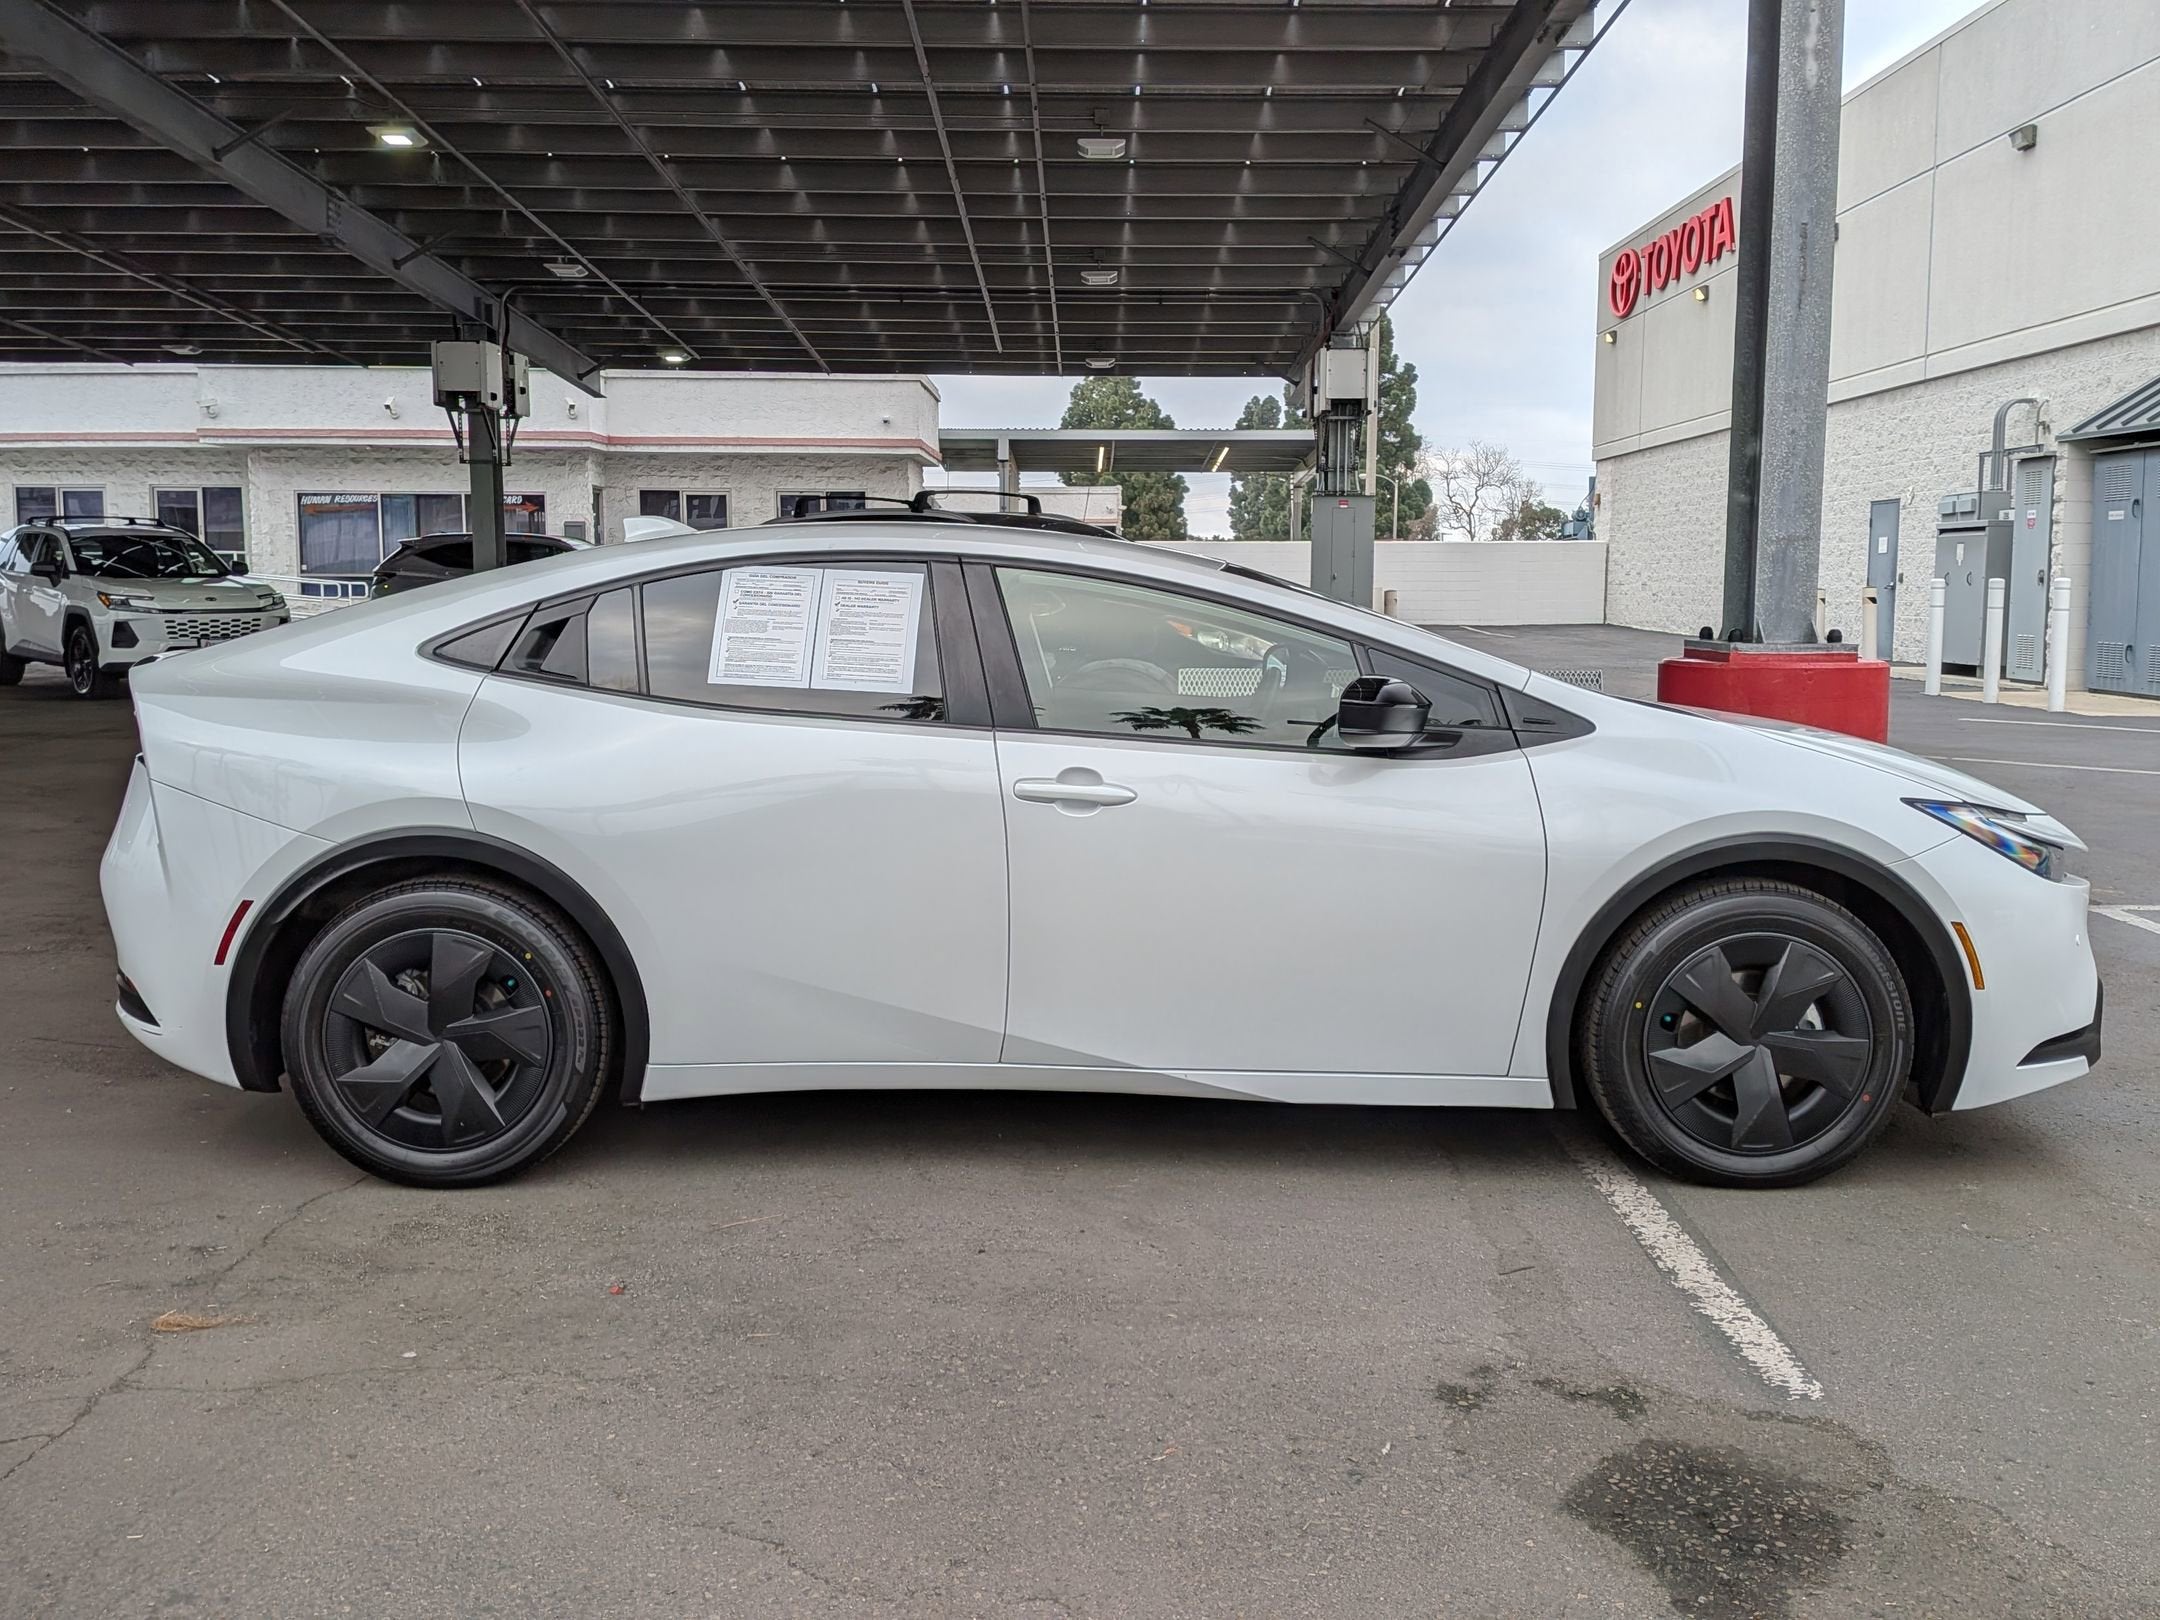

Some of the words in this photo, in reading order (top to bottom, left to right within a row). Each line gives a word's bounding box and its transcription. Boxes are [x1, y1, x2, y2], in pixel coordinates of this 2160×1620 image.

[1641, 197, 1736, 296] TOYOTA
[300, 495, 332, 505] HUMAN
[334, 494, 378, 504] RESOURCES
